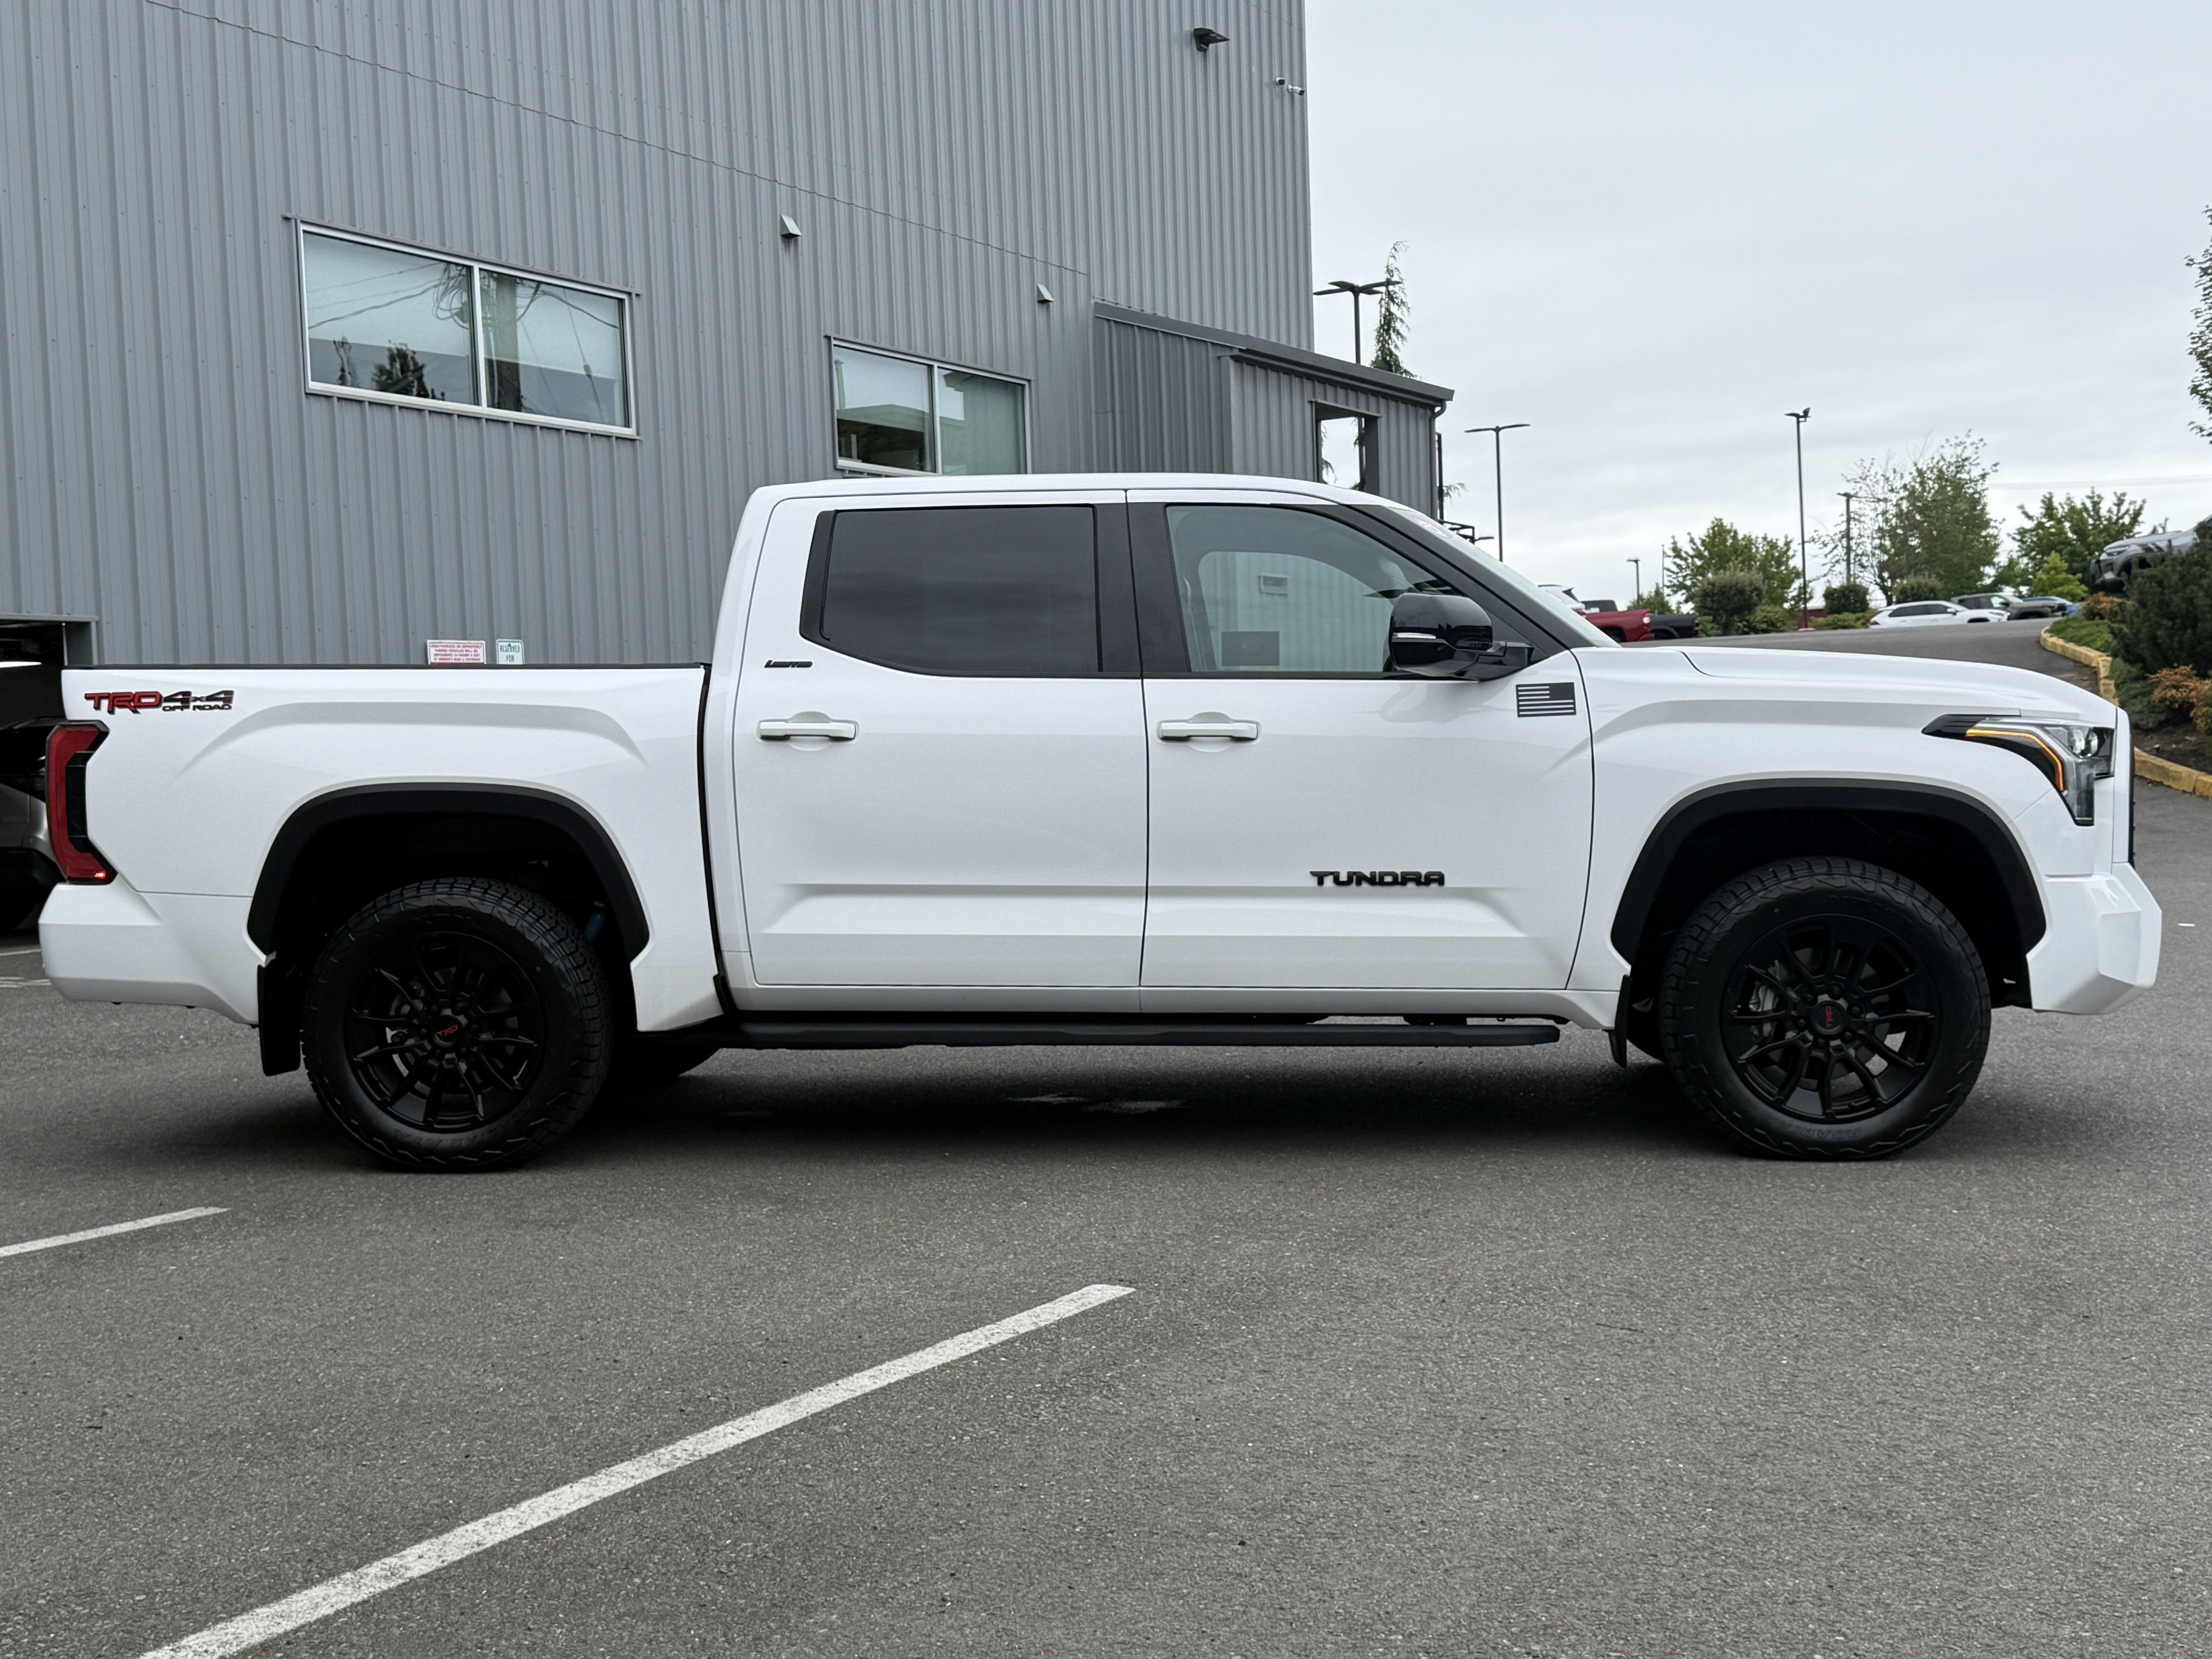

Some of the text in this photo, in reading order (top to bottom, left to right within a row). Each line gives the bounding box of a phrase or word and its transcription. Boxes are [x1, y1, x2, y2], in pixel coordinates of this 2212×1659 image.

[500, 644, 520, 653] RESERVED
[84, 691, 163, 715] TRD
[1310, 871, 1445, 886] TUNDRA
[436, 1025, 459, 1036] TRD
